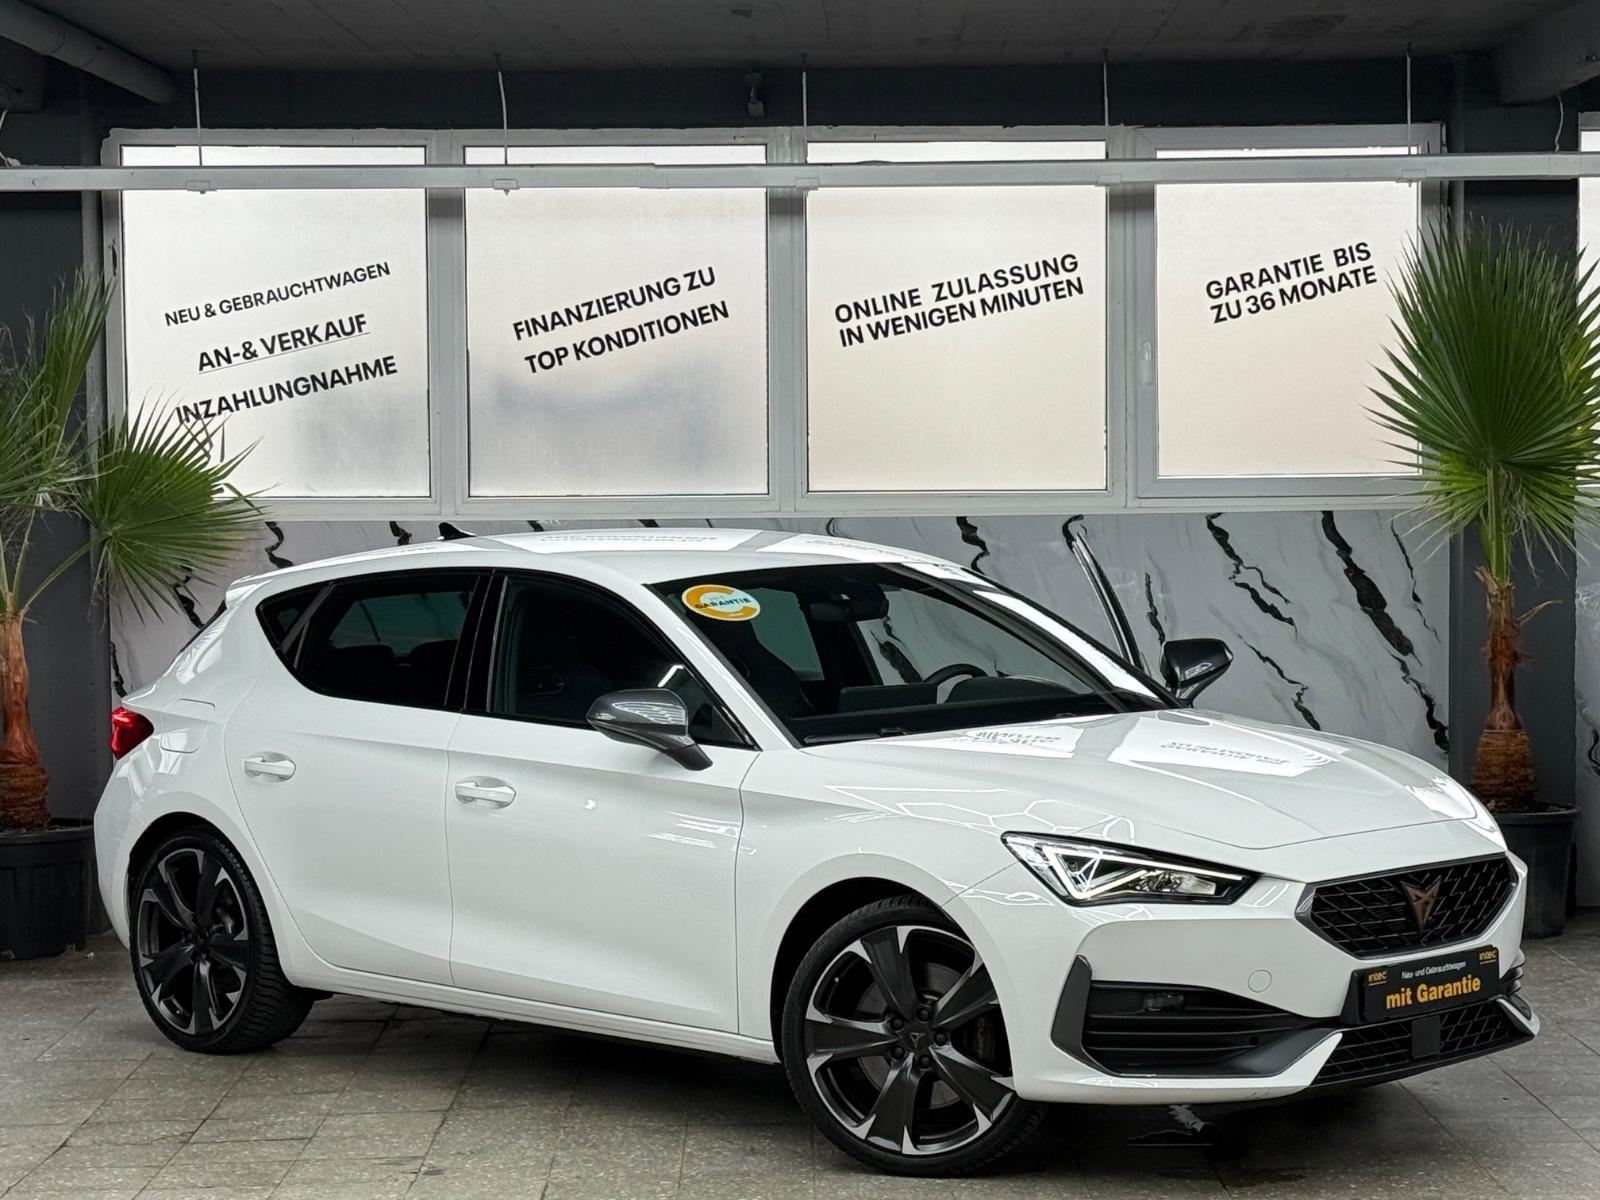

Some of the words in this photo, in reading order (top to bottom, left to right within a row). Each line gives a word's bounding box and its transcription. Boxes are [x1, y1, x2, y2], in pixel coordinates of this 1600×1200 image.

[164, 306, 201, 326] NEU
[203, 303, 217, 318] &
[219, 261, 391, 315] GEBRAUCHTWAGEN
[834, 288, 922, 323] ONLINE
[931, 253, 1079, 302] ZULASSUNG
[1206, 254, 1324, 299] GARANTIE
[1333, 242, 1371, 267] BIS
[1210, 299, 1242, 324] ZU
[1245, 291, 1276, 314] 36
[1278, 265, 1377, 306] MONATE
[260, 314, 367, 354] VERKAUF
[513, 277, 681, 341] FINANZIERUNG
[683, 266, 716, 291] ZU
[839, 325, 864, 347] IN
[866, 301, 977, 340] WENIGEN
[980, 277, 1084, 316] MINUTEN
[524, 346, 569, 373] TOP
[572, 300, 730, 361] KONDITIONEN
[176, 356, 398, 424] INZAHLUNGNAHME
[1386, 987, 1413, 1009] mit
[1416, 974, 1481, 1003] Garantie
[1414, 968, 1425, 977] und
